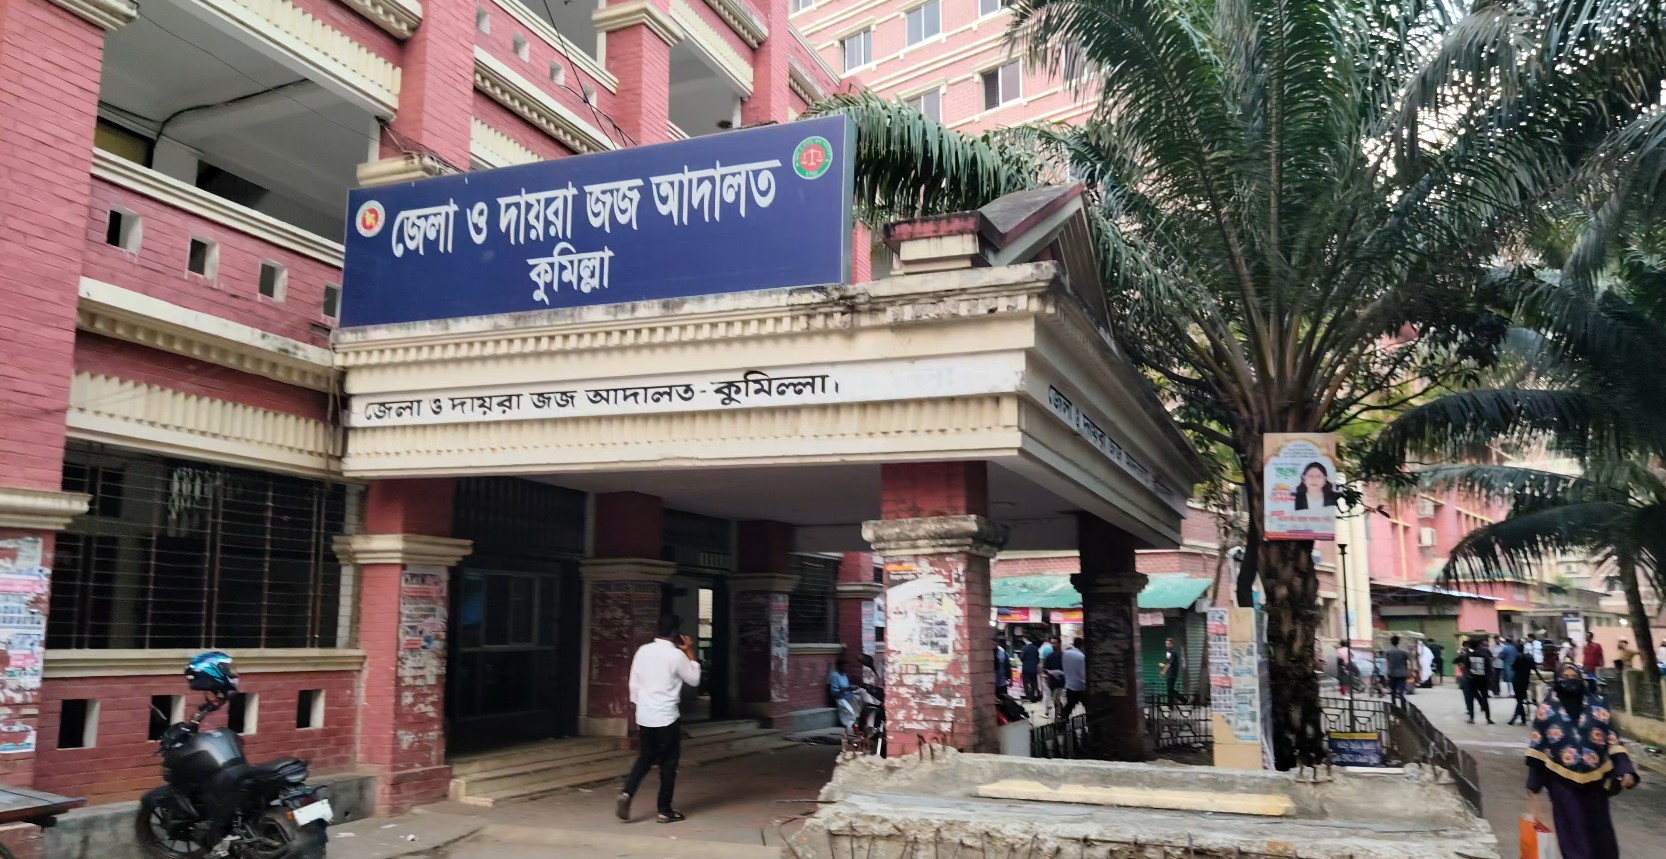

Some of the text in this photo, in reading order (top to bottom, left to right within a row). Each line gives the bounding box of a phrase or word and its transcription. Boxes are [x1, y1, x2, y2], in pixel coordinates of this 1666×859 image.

[392, 159, 782, 257] জেলা ও দায়রা জজ আদালত
[527, 242, 614, 305] কুমিল্লা
[365, 399, 423, 420] জেলা
[429, 398, 443, 415] ও
[448, 393, 524, 416] দায়রা
[529, 390, 578, 409] জজ
